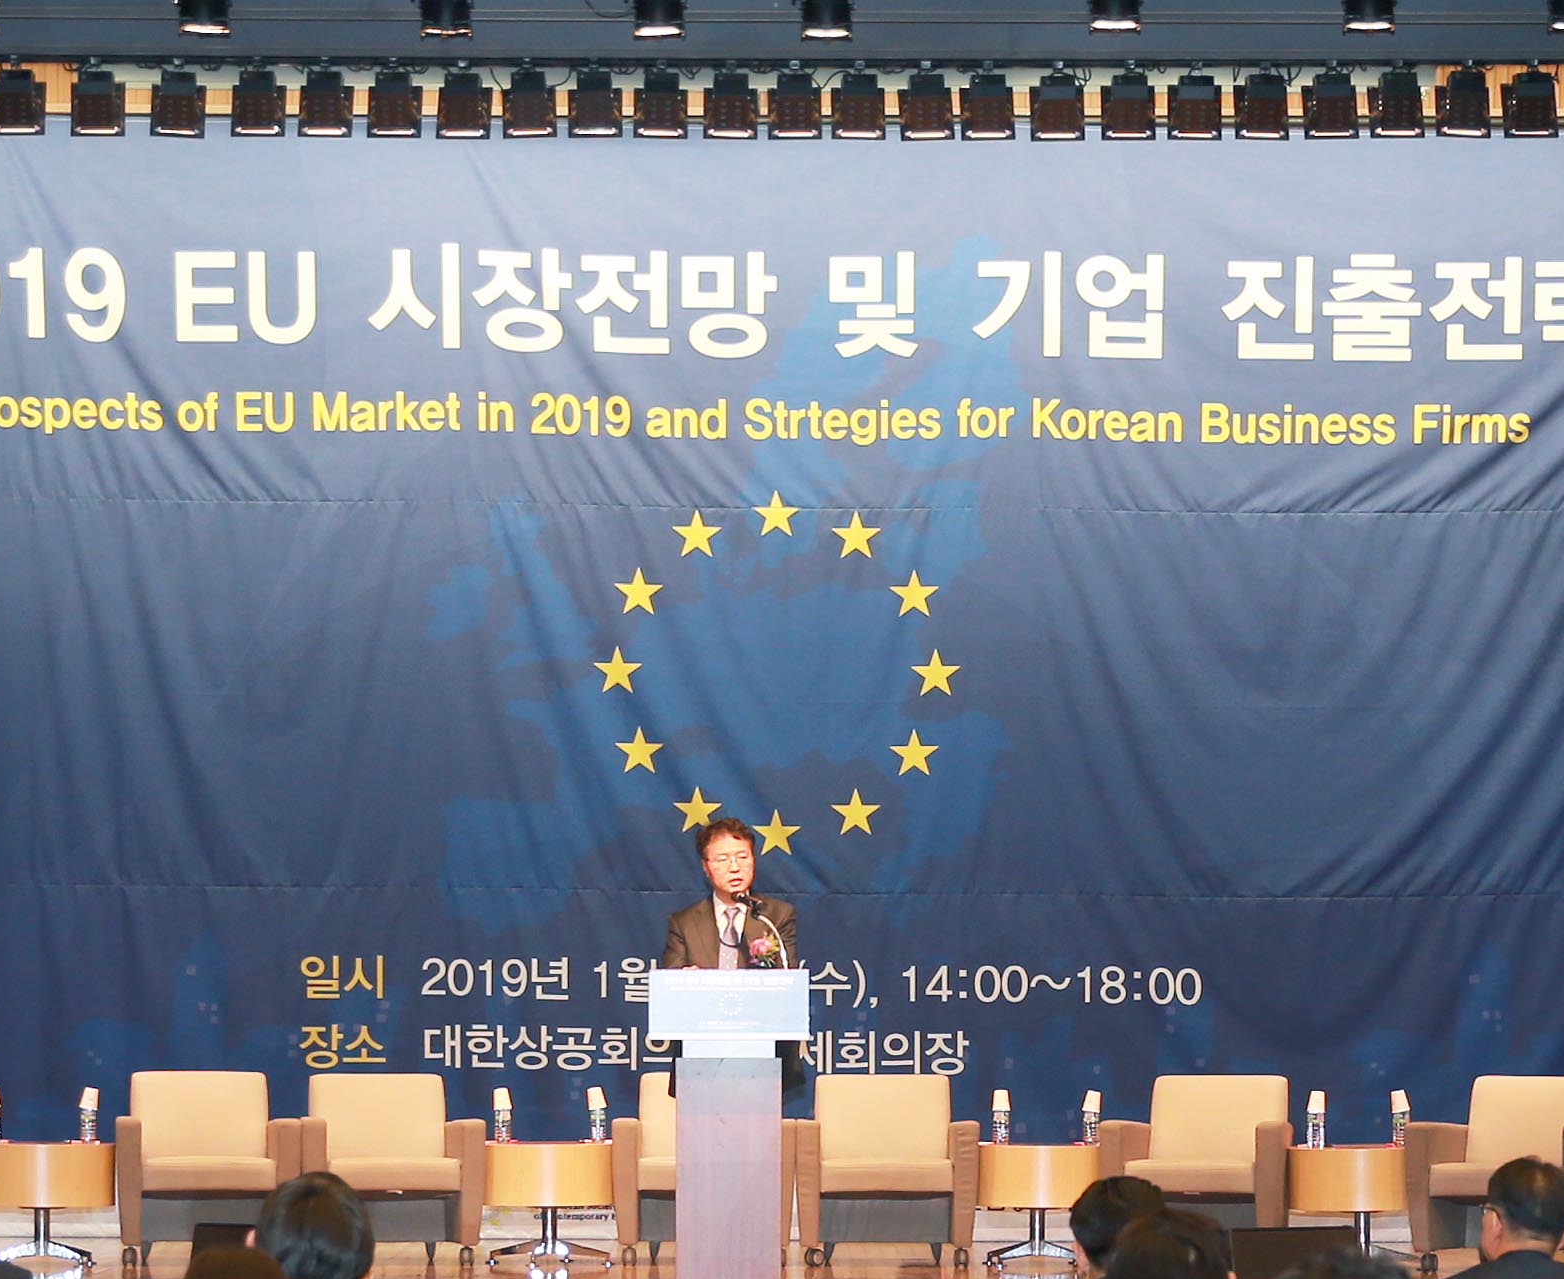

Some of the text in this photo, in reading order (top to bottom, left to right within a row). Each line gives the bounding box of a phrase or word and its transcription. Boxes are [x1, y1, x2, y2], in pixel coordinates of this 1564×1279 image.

[173, 250, 317, 346] EU
[366, 241, 779, 360] 시장전망
[828, 250, 920, 359] 및
[971, 249, 1165, 360] 기업
[175, 391, 221, 433] of
[234, 391, 296, 433] EU
[311, 391, 463, 432] Market
[477, 391, 516, 431] in
[529, 392, 634, 437] 2019
[644, 399, 729, 440] and
[743, 397, 943, 446] Strtegies
[955, 397, 1016, 438] for
[1031, 398, 1185, 443] Korean
[1199, 402, 1397, 445] Business
[1411, 402, 1533, 444] Firms
[299, 955, 386, 1000] 일시
[421, 956, 569, 1001] 2019년
[799, 960, 879, 1009] 수),
[299, 1024, 387, 1069] 장소
[801, 1029, 970, 1076] 제회의장
